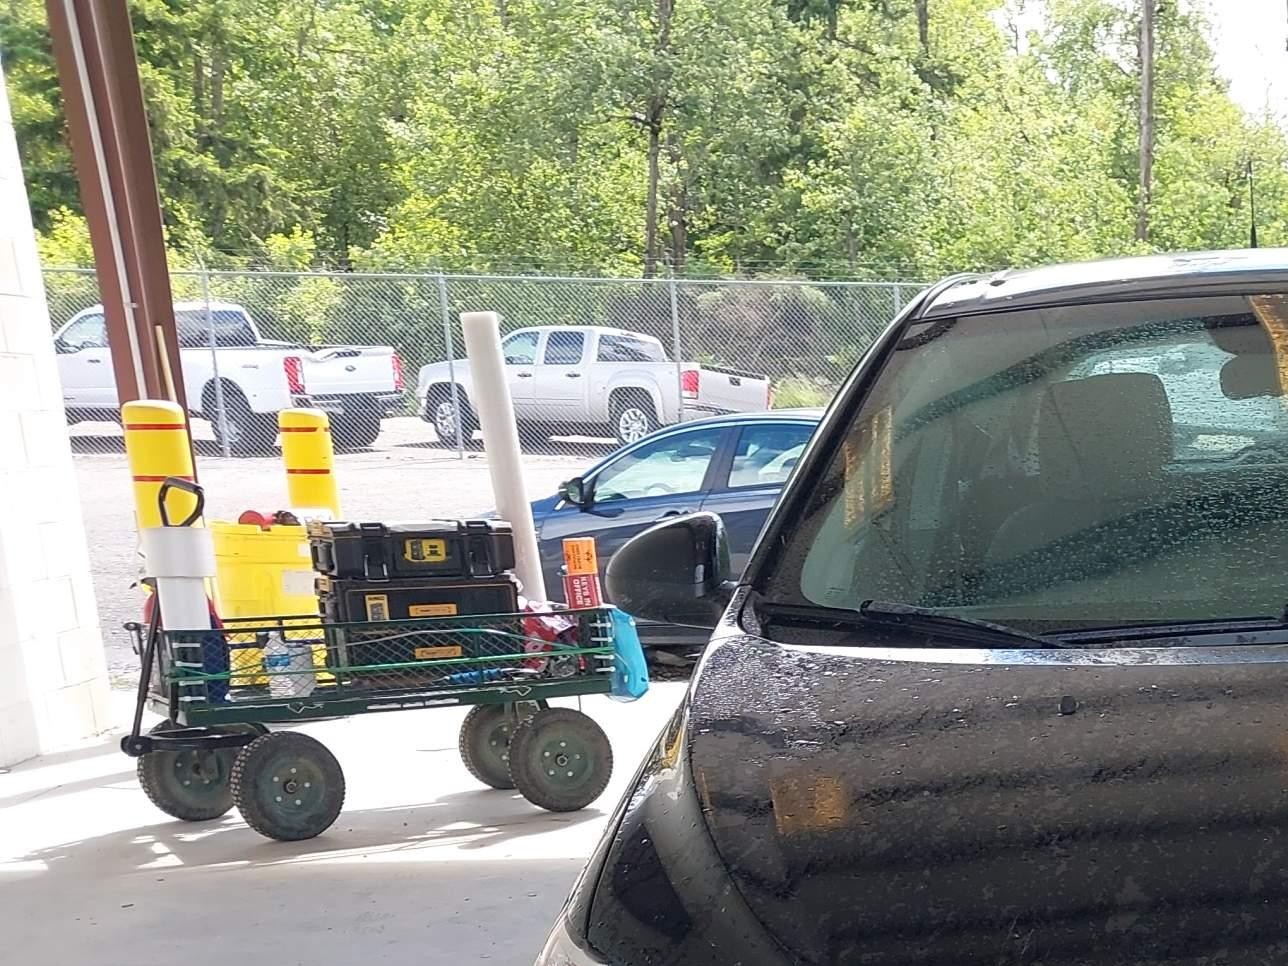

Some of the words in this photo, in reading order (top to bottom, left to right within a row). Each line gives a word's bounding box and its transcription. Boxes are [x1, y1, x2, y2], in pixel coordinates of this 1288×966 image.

[573, 579, 584, 605] OFFICE
[580, 576, 590, 596] KEYS
[584, 597, 592, 606] IN
